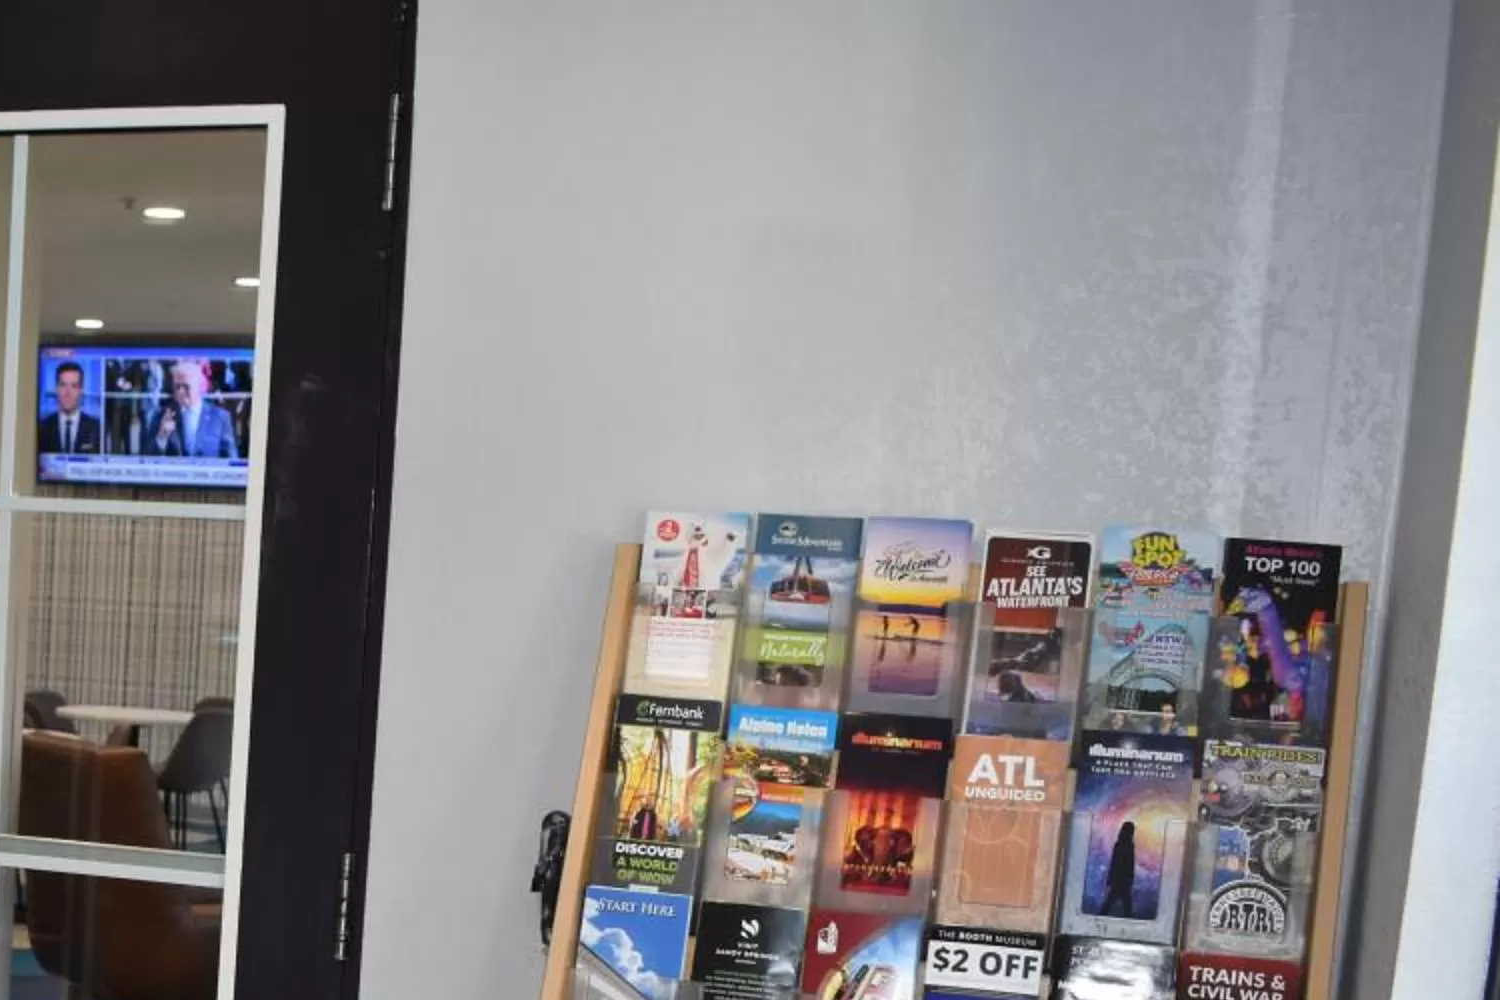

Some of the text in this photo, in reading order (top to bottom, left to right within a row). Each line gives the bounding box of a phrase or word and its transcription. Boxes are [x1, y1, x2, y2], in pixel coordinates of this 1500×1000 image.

[1132, 533, 1177, 556] FUN
[1132, 549, 1188, 569] SPOT
[1244, 556, 1321, 577] TOP 100
[1026, 565, 1047, 577] SEE
[986, 576, 1083, 597] ATLANTA'S
[996, 595, 1070, 609] WATERFRONT
[649, 703, 704, 719] Fernbank
[967, 753, 1045, 787] ATL
[964, 785, 1045, 802] UNGUIDED
[615, 842, 684, 860] DISCOVER
[617, 856, 677, 874] A WORLD
[599, 898, 677, 917] START HERE
[938, 930, 1037, 947] THE BOOTH MUSEUM
[933, 946, 969, 972] $2
[979, 951, 1040, 980] OFF
[1189, 965, 1285, 991] TRAINS &
[1187, 983, 1235, 1000] CIVIL
